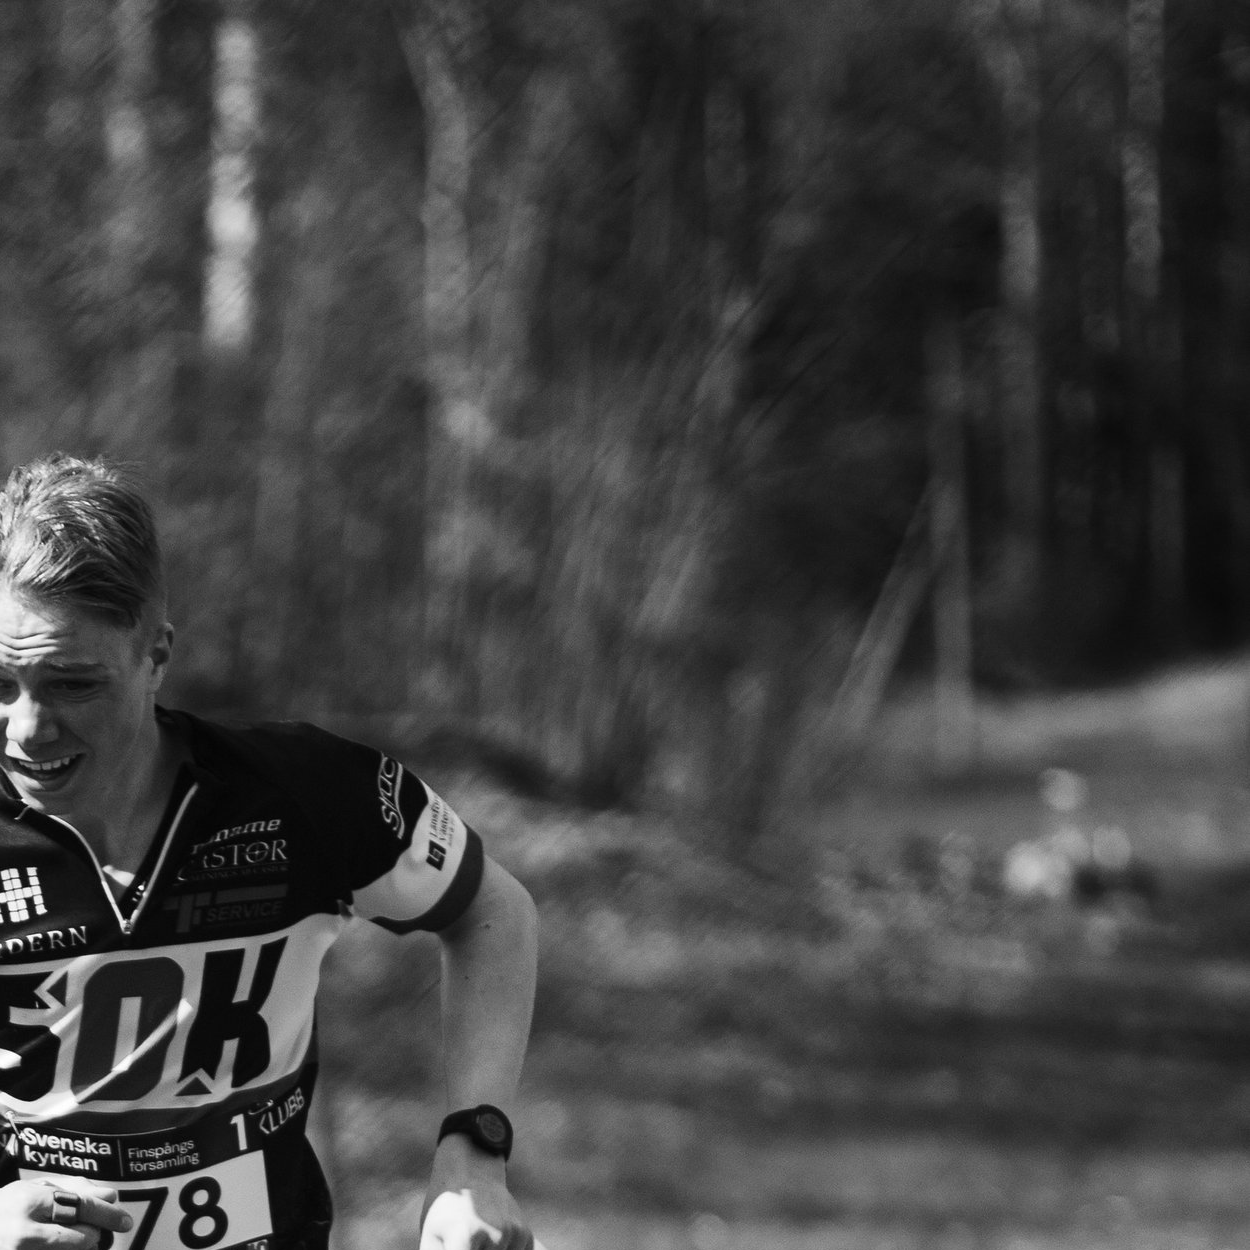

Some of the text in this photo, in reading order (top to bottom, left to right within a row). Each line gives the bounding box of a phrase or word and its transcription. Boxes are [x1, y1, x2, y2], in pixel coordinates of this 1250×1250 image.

[190, 819, 282, 855] name
[206, 901, 283, 922] SERVICE
[22, 1127, 111, 1155] Svenska
[230, 1113, 247, 1151] 1
[24, 1145, 97, 1171] kyrkan
[128, 1140, 194, 1159] Finspångs
[129, 1153, 199, 1172] församling
